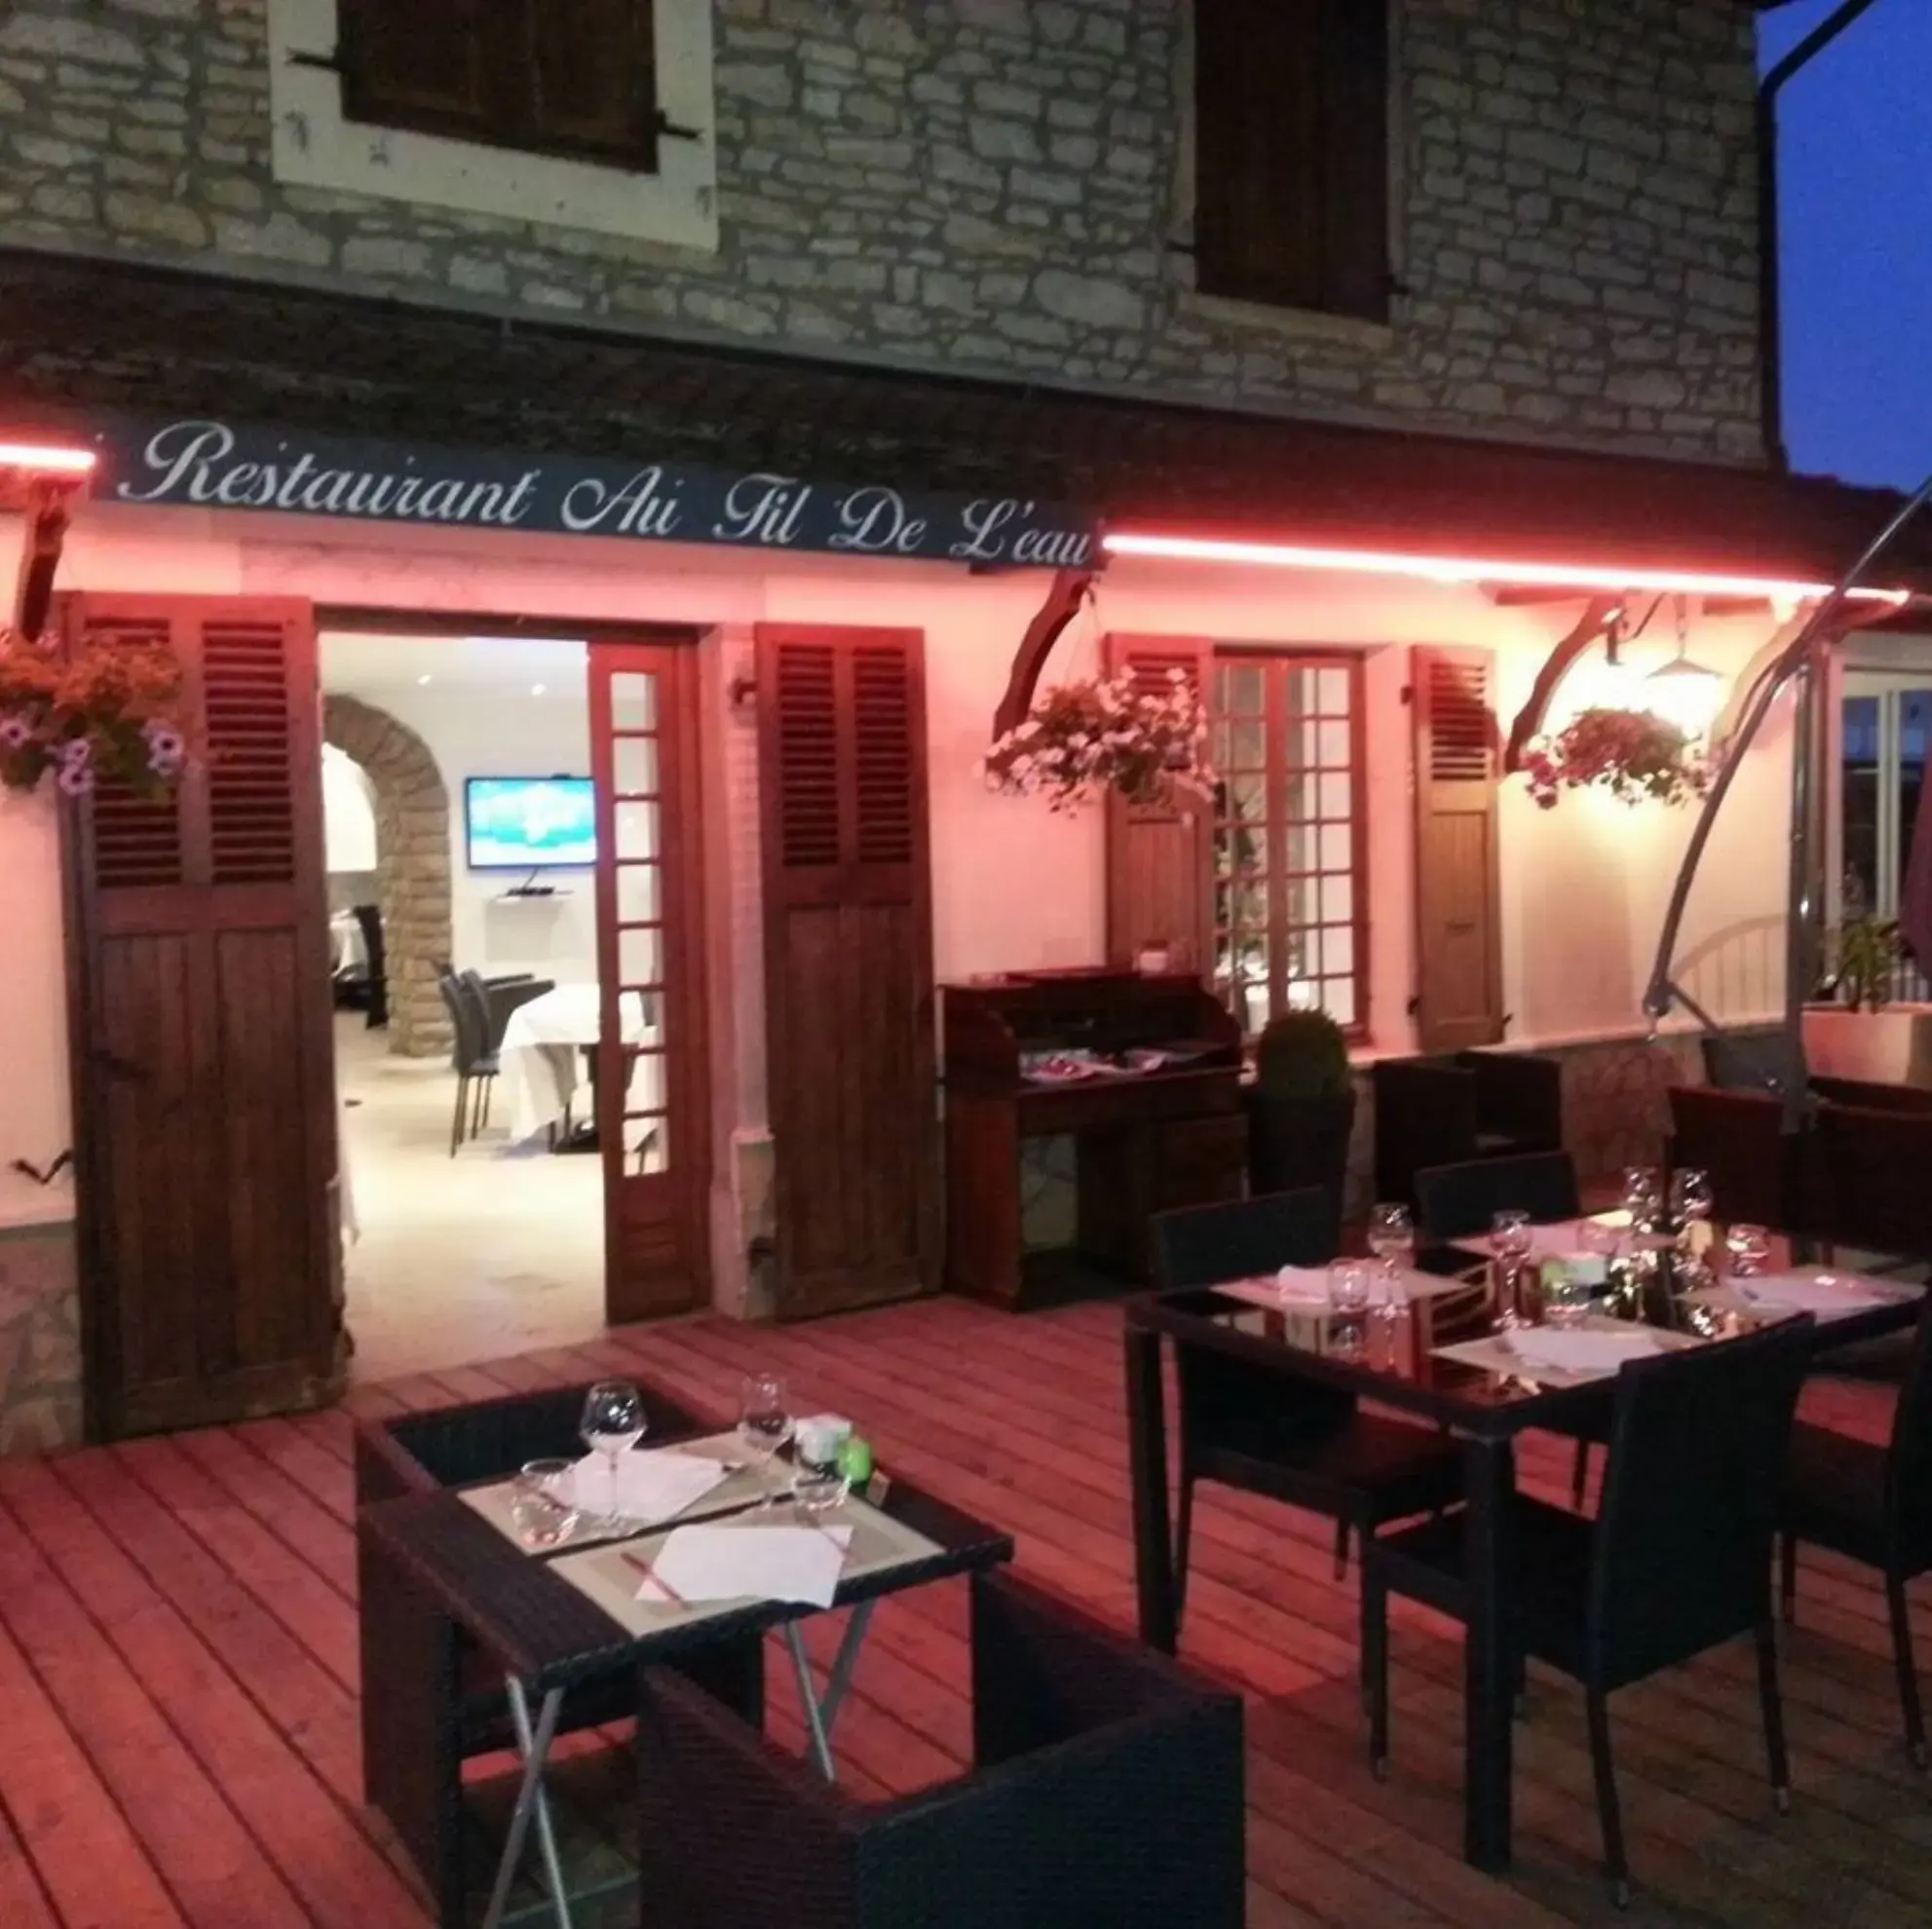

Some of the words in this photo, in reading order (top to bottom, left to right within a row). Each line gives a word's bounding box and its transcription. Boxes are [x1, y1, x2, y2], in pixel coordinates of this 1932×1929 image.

[117, 420, 539, 524] Restaurant
[560, 466, 682, 535] Au
[712, 473, 812, 544] Fil
[827, 486, 927, 552] De
[949, 498, 1092, 565] L'eau
